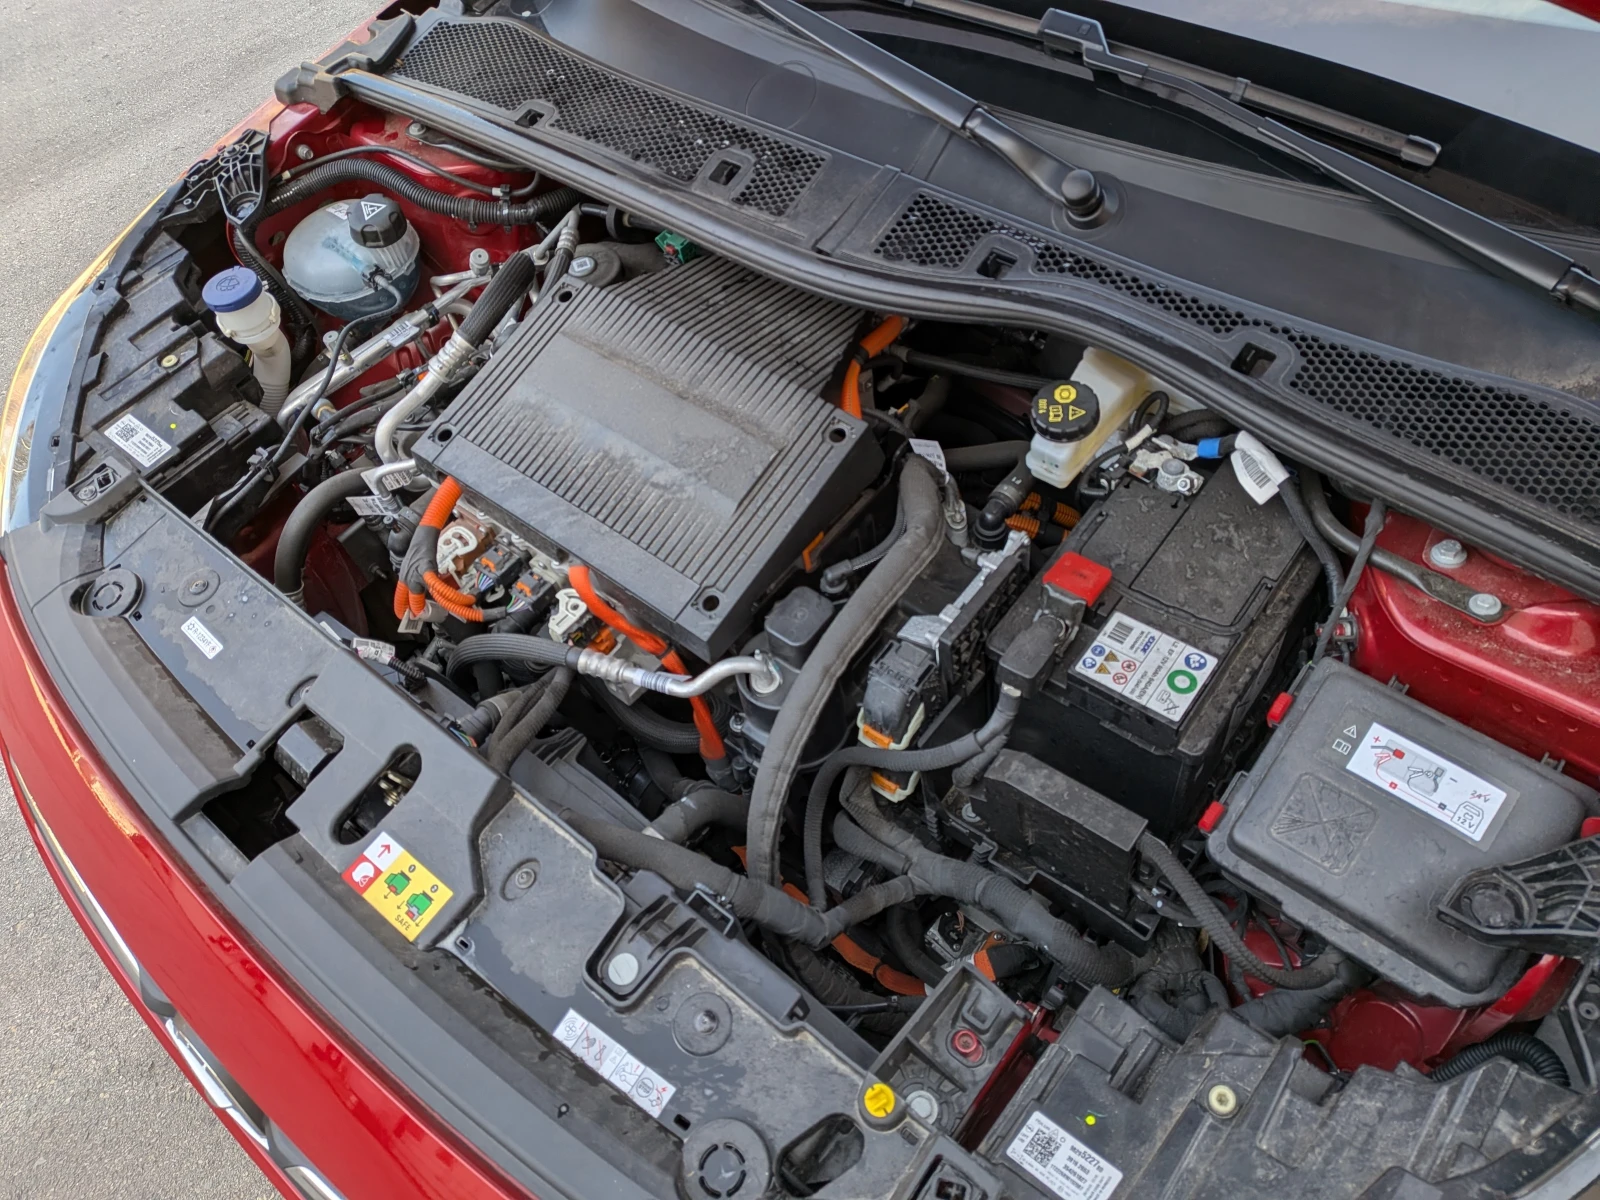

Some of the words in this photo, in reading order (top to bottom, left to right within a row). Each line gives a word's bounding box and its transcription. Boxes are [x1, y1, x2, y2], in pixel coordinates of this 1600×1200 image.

[1456, 816, 1467, 825] 12
[1468, 821, 1475, 829] V
[394, 914, 411, 931] SAFE
